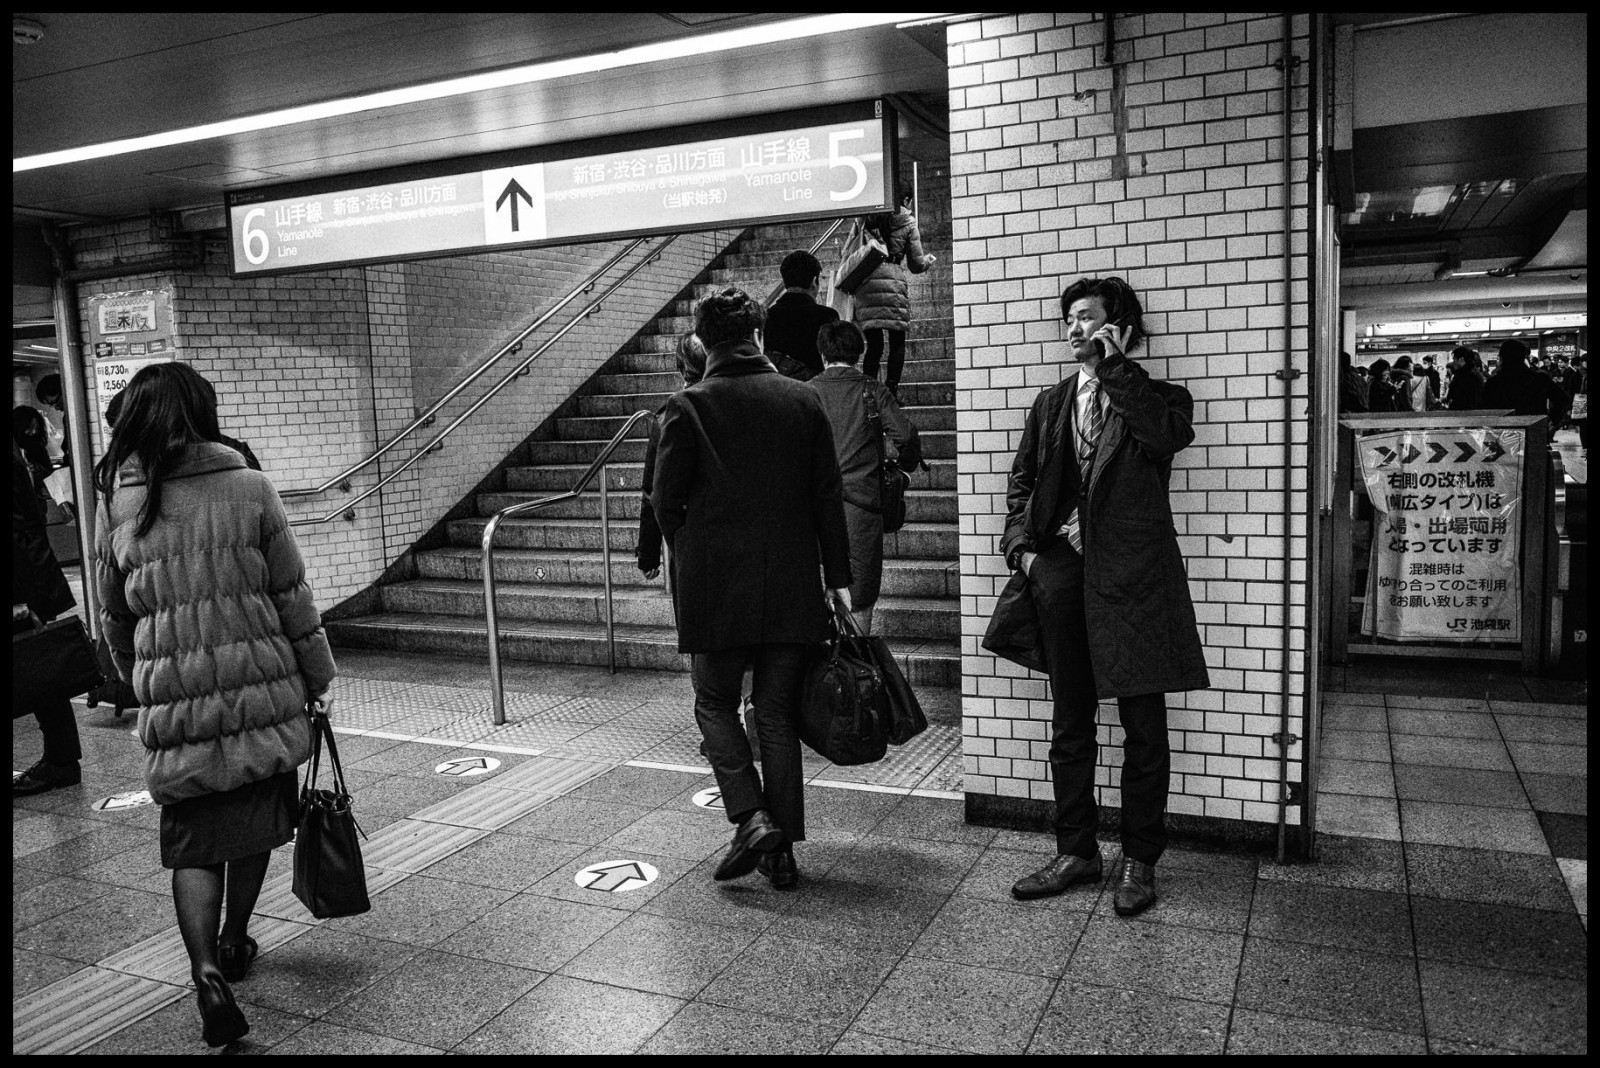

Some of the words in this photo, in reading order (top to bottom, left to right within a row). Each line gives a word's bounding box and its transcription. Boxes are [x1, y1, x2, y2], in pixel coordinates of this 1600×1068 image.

[741, 136, 811, 169] 山手線
[573, 147, 726, 184] 新宿・渋谷・品川方面
[829, 128, 867, 201] 5
[617, 180, 656, 194] Shibuya
[669, 174, 727, 188] Shinagawa
[744, 169, 812, 187] Yamanote
[333, 183, 457, 216] 新宿・渋谷・品川方面
[783, 188, 813, 202] Line
[275, 202, 323, 227] 山手線
[242, 208, 269, 265] 6
[277, 228, 323, 242] Yamanote
[278, 245, 297, 258] Line
[104, 308, 150, 331] 週末パス
[1387, 471, 1495, 489] 右側の改札機
[1409, 563, 1465, 576] 混雑時は
[1447, 618, 1467, 629] JR
[1471, 618, 1511, 630] 池袋駅
